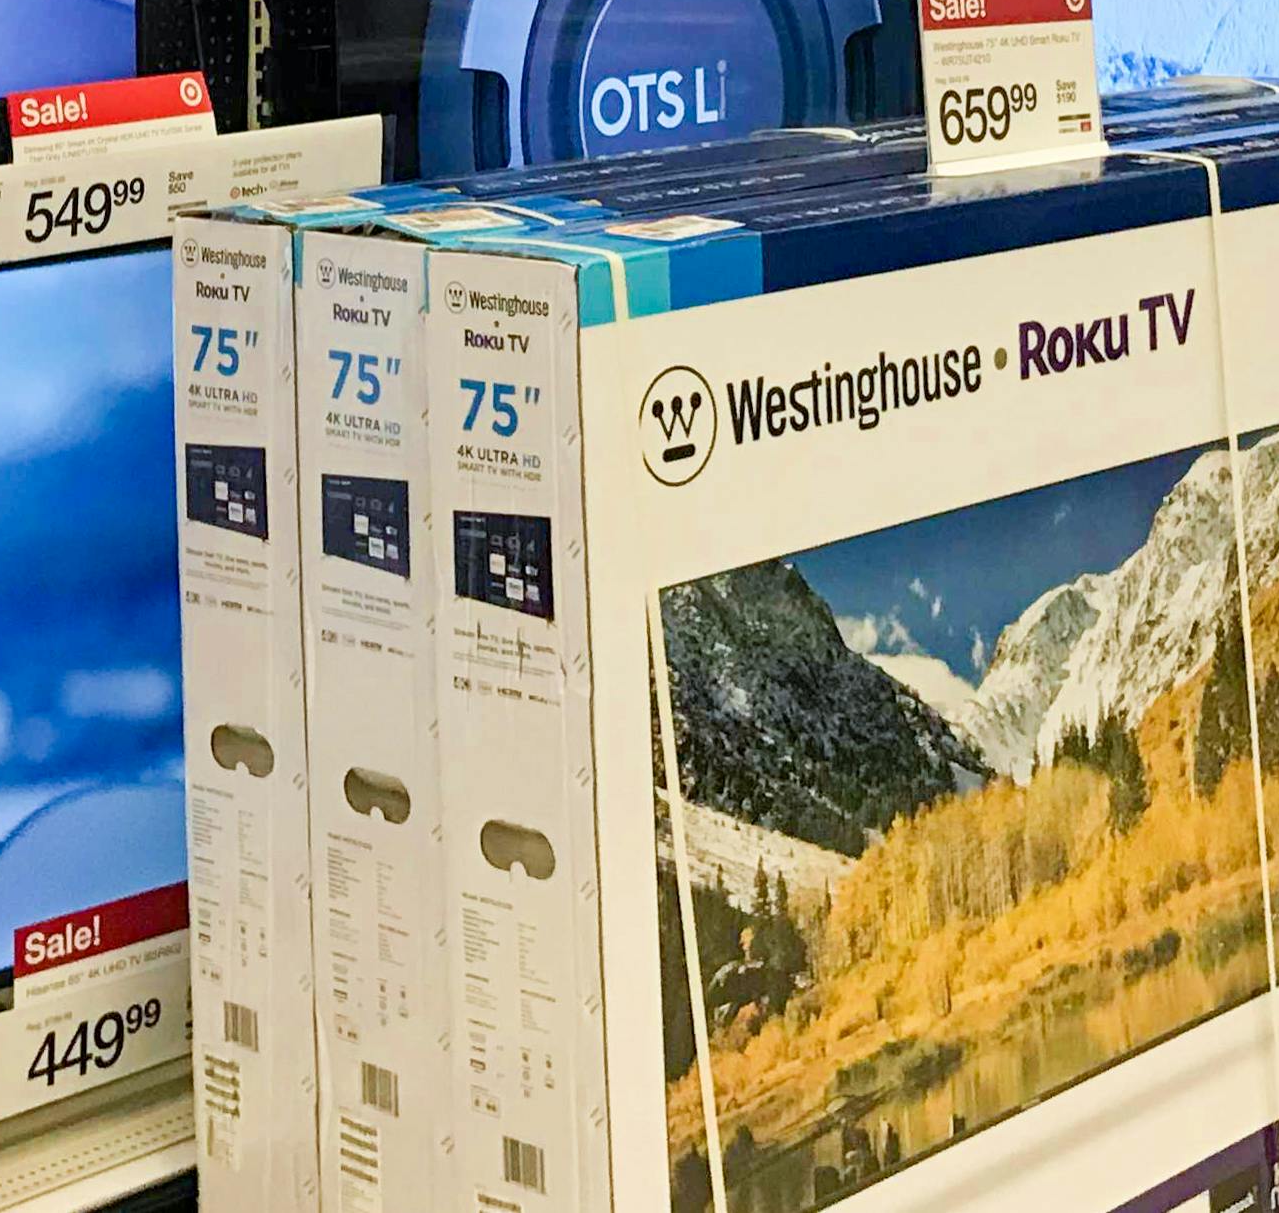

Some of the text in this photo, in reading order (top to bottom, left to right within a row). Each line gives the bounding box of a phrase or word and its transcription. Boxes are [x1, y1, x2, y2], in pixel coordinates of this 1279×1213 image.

[1056, 79, 1076, 91] Save
[21, 92, 88, 127] Sale!
[591, 69, 683, 137] OTS
[168, 170, 194, 183] Save
[242, 186, 263, 197] tech
[201, 246, 267, 270] Westinghouse
[195, 281, 250, 303] Roku TV
[338, 269, 408, 294] Westinghouse
[333, 303, 391, 327] Roku TV
[469, 290, 550, 318] Westinghouse
[191, 324, 258, 378] 75"
[464, 329, 530, 354] Roku TV
[328, 349, 401, 406] 75"
[725, 288, 1196, 446] Westinghouse Roku TV
[188, 383, 258, 404] 4K ULTRA HD
[460, 378, 541, 438] 75"
[326, 412, 401, 435] 4K ULTRA HD
[457, 445, 541, 470] 4K ULTRA HD
[24, 915, 101, 965] Sale!
